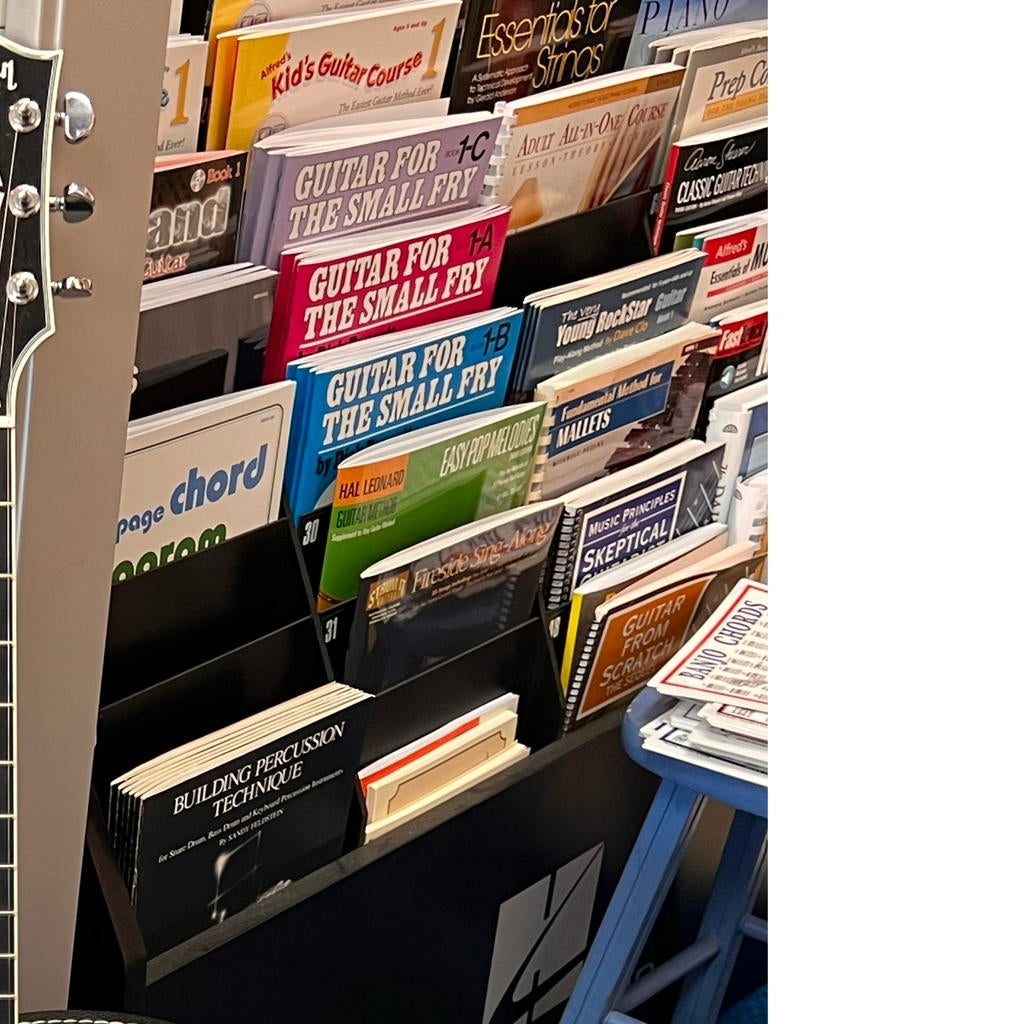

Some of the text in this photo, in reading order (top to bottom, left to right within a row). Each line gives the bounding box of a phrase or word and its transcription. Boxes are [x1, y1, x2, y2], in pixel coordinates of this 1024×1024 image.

[421, 17, 446, 80] 1
[476, 0, 585, 59] Essentials
[260, 51, 292, 80] Alfred's
[271, 50, 424, 101] Kid's Guitar Course
[532, 41, 604, 89] Strings
[708, 70, 746, 100] Prep
[170, 58, 191, 127] 1
[338, 102, 350, 114] The
[393, 90, 416, 102] Method
[294, 139, 442, 201] GUITAR FOR
[458, 130, 490, 165] 1-C
[206, 166, 242, 184] Book 1
[677, 175, 716, 204] CLASSIC
[287, 166, 479, 241] THE SMALL FRY
[468, 223, 494, 257] 1-A
[715, 239, 748, 260] Alfred's
[308, 233, 453, 303] GUITAR FOR
[303, 256, 490, 341] THE SMALL FRY
[556, 318, 596, 348] Young
[595, 298, 654, 334] RockStar
[654, 287, 688, 312] Guitar
[562, 310, 577, 323] The
[482, 321, 511, 356] 1-B
[326, 351, 417, 408] GUITAR
[418, 335, 467, 380] FOR
[617, 371, 650, 398] Method
[649, 371, 663, 387] for
[322, 400, 375, 446] THE
[375, 371, 455, 428] SMALL
[456, 354, 504, 405] FRY
[439, 442, 472, 477] EASY
[469, 431, 494, 465] POP
[488, 415, 541, 460] MELODIES
[556, 408, 612, 449] MALLETS
[170, 443, 268, 515] chord
[316, 455, 332, 477] by
[339, 469, 405, 500] HAL LEONARD
[116, 506, 165, 544] page
[303, 519, 320, 546] 30
[336, 504, 368, 529] GUITAR
[588, 489, 677, 538] MUSIC PRINCIPLES
[412, 553, 470, 594] Fireside
[469, 521, 555, 567] Sing-Along
[582, 518, 669, 573] SKEPTICAL
[325, 617, 338, 643] 31
[621, 619, 671, 657] FROM
[622, 594, 687, 638] GUITAR
[599, 636, 675, 687] SCRATCH
[678, 648, 728, 681] BANJO
[713, 600, 768, 646] CHORDS
[173, 721, 347, 816] BUILDING PERCUSSION
[212, 761, 304, 818] TECHNIQUE
[223, 818, 241, 831] Drum
